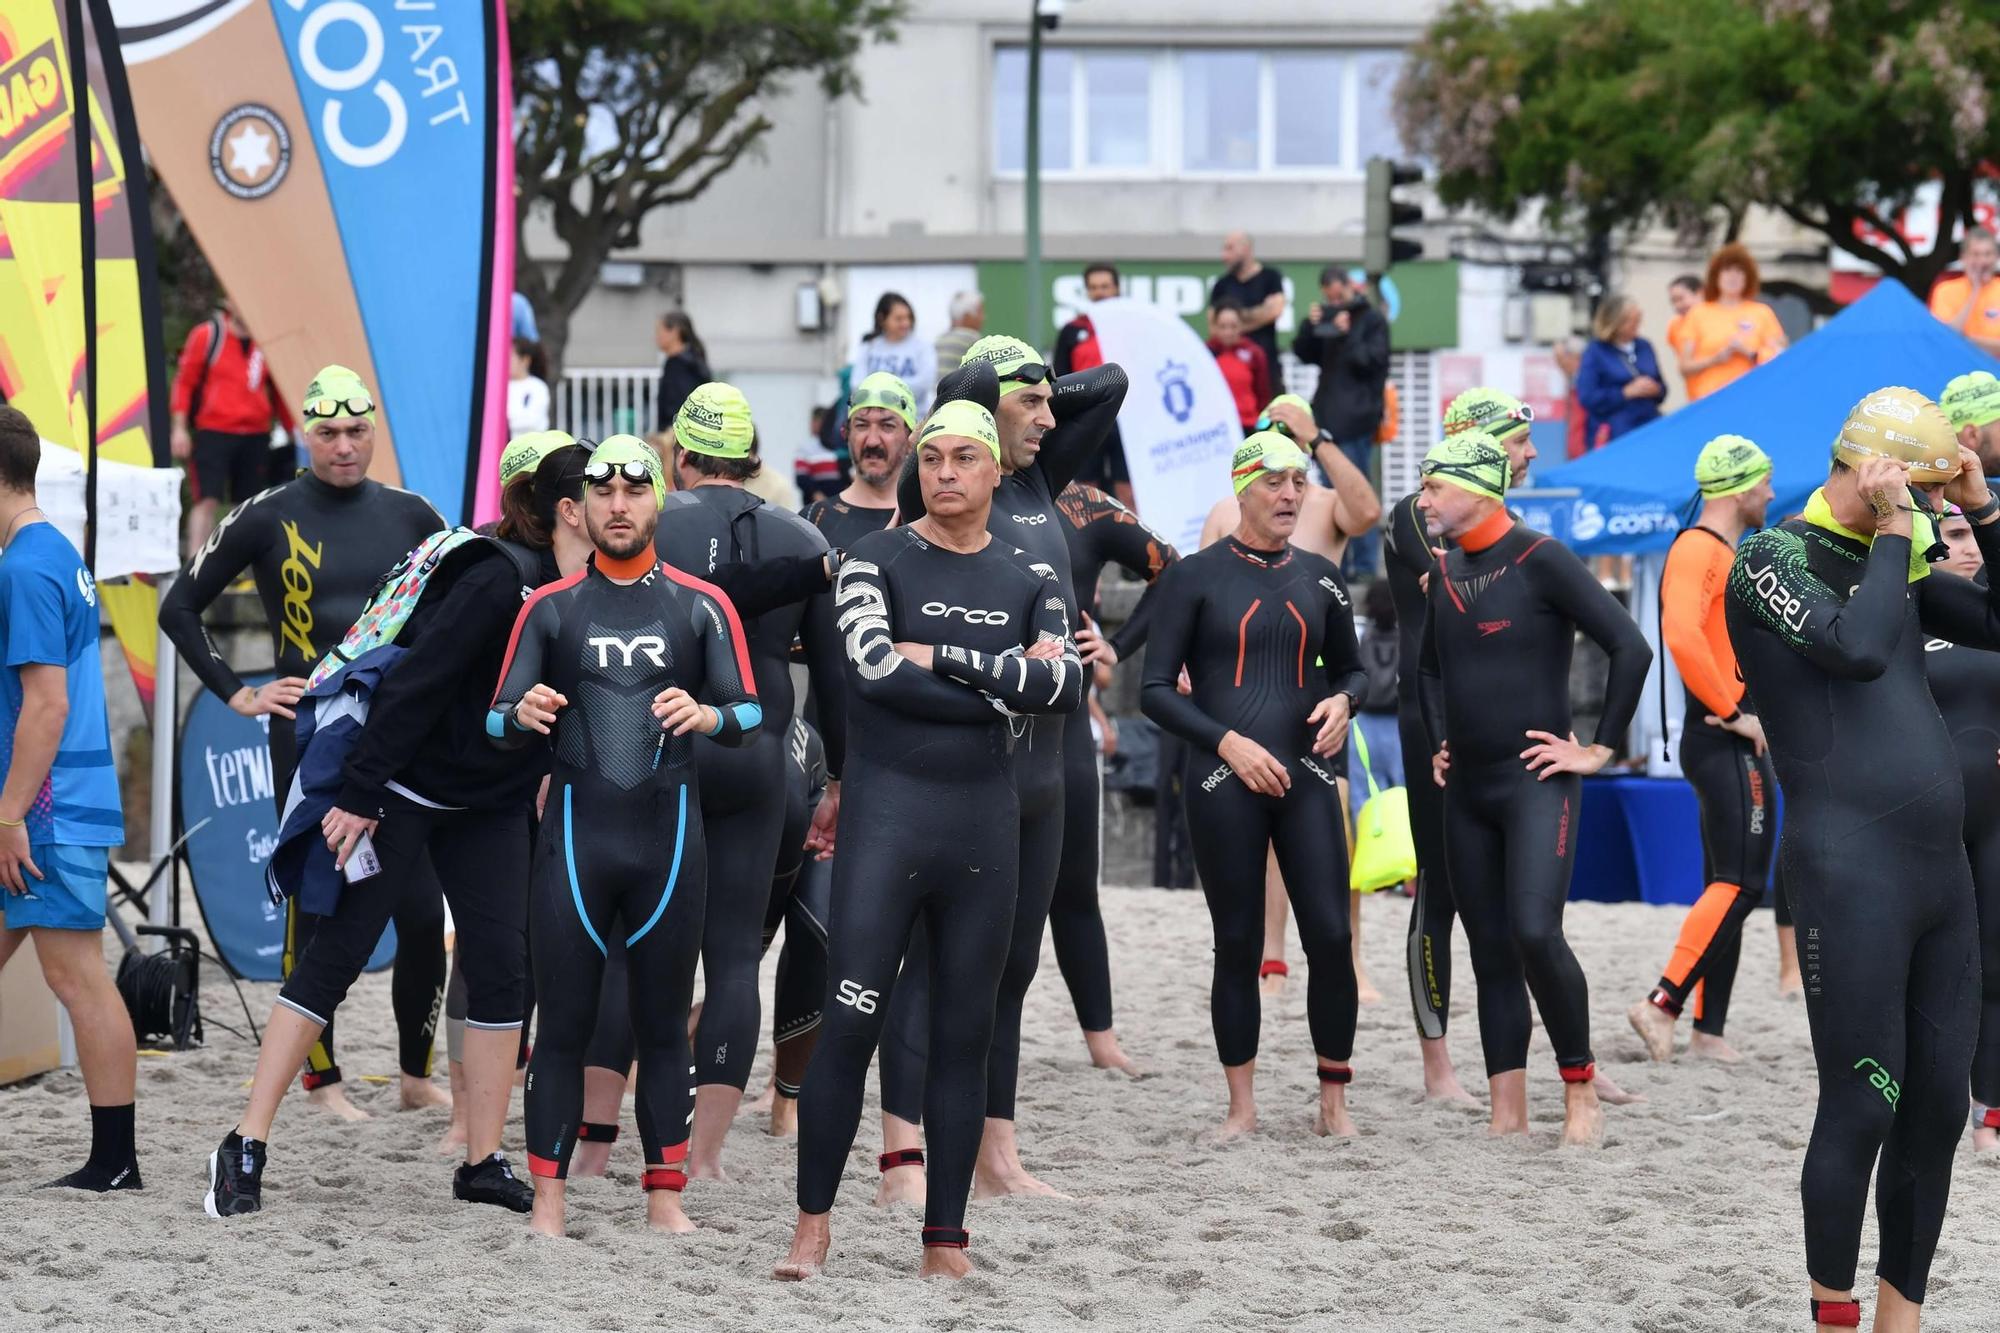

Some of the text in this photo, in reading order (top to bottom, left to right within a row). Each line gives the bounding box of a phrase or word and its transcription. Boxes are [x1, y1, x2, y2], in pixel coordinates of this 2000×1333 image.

[1057, 384, 1086, 395] ATHLEX
[1011, 514, 1047, 526] orca
[1608, 513, 1680, 534] COSTA
[1318, 576, 1348, 606] 2XU
[1744, 563, 1811, 632] razor
[921, 602, 1009, 626] orca
[1477, 619, 1511, 631] speedo
[588, 636, 666, 668] TYR
[1201, 763, 1234, 792] RACE
[1556, 815, 1568, 859] speedo
[836, 979, 879, 1014] S6
[715, 1041, 728, 1064] zeal
